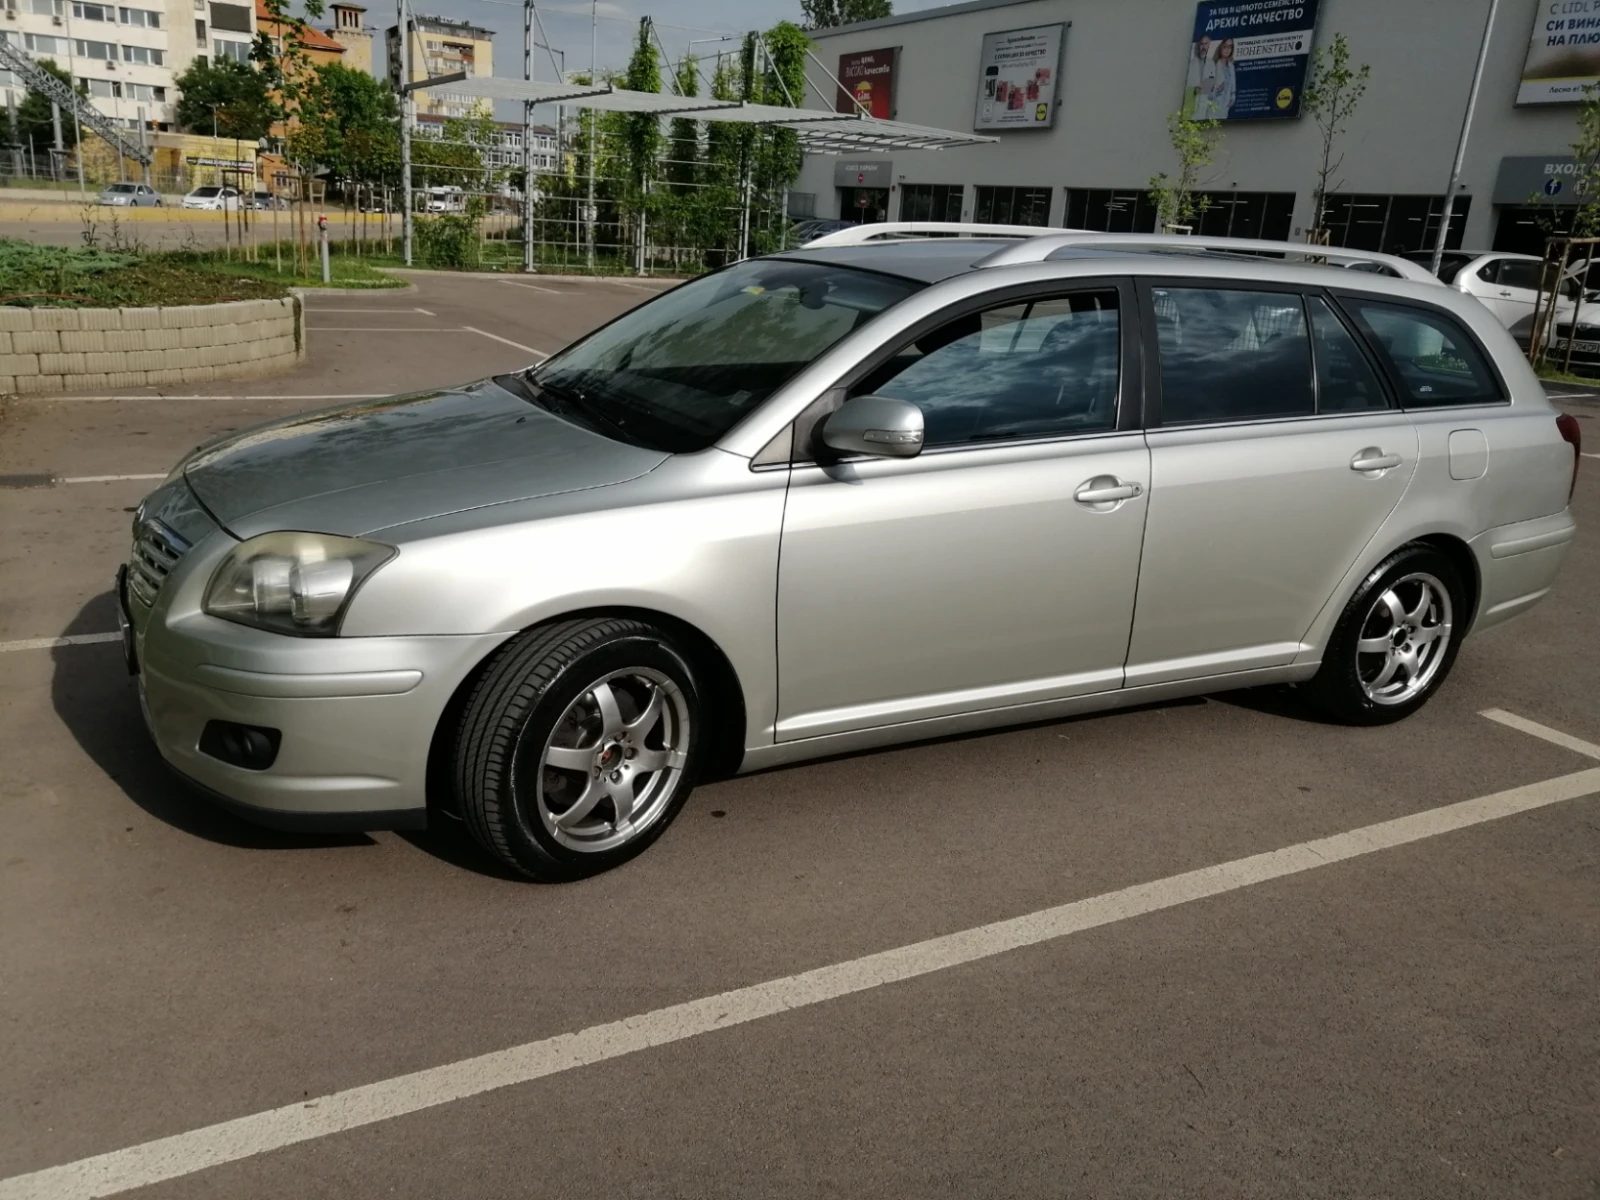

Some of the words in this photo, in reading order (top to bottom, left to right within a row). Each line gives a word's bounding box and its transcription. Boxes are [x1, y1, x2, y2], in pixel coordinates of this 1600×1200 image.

[1209, 8, 1217, 17] ЗА
[1218, 7, 1229, 15] ТЕБ
[1236, 2, 1263, 13] ЦЯЛОТО
[1562, 2, 1589, 14] LIDL
[1205, 17, 1239, 32] ДРЕХИ
[1240, 15, 1248, 26] С
[1249, 8, 1304, 26] КАЧЕСТВО
[1546, 19, 1565, 31] СИ
[1546, 34, 1565, 46] НА
[1236, 41, 1295, 57] HOHENSTEIN
[1544, 163, 1586, 177] ВХОД
